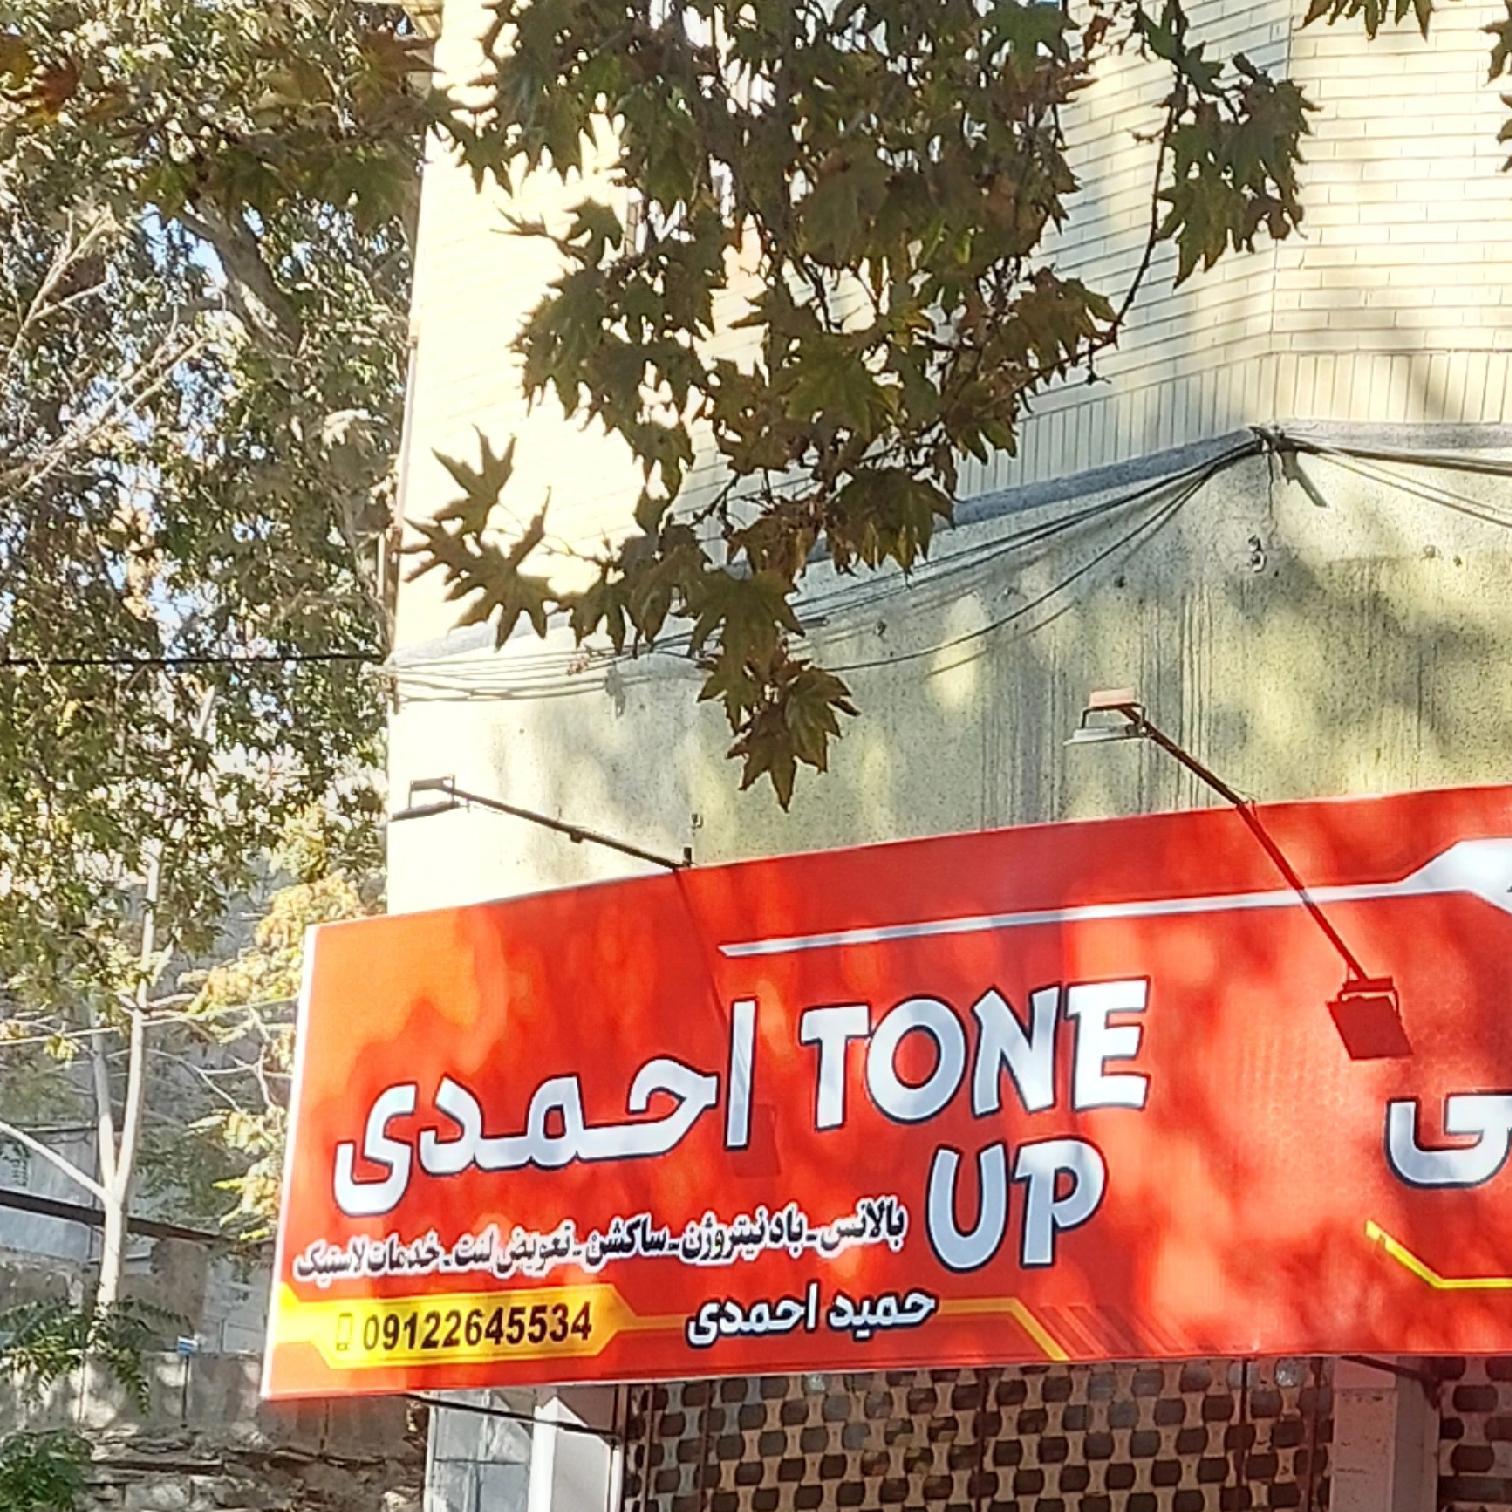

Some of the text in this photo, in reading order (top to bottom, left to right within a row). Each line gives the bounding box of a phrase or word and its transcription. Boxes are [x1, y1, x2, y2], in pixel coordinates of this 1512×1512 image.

[332, 999, 755, 1217] احمدی
[799, 978, 1150, 1131] TONE
[923, 1136, 1106, 1271] UP
[363, 1301, 592, 1350] 09122645534
[687, 1281, 938, 1348] حمید احمدی
